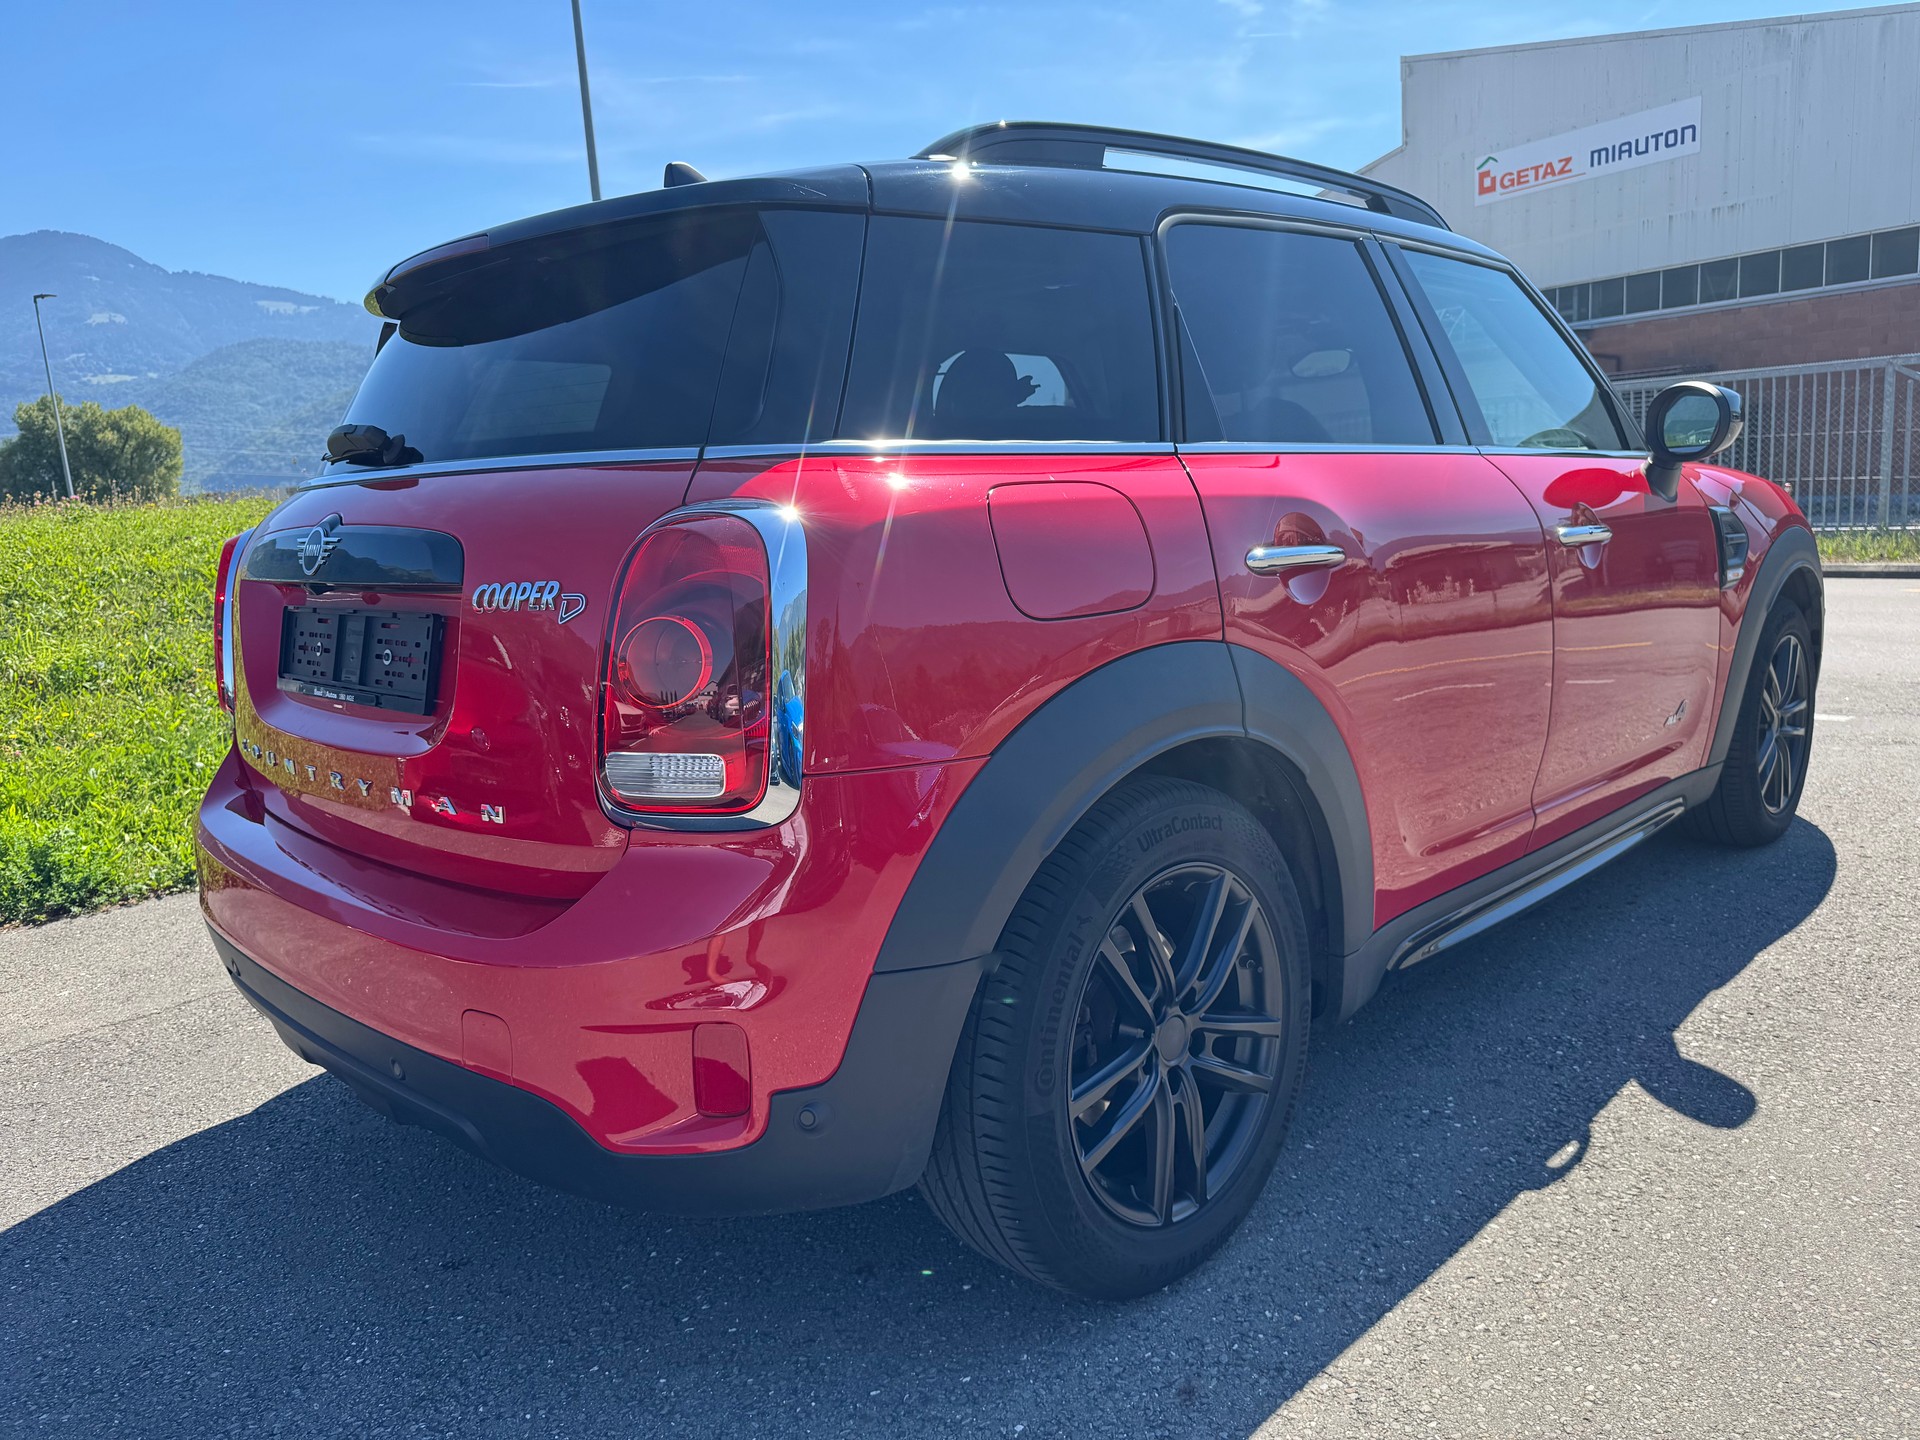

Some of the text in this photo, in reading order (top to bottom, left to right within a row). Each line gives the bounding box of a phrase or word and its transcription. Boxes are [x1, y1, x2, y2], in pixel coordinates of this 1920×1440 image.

[1500, 124, 1697, 190] GETAZ MIAUTON
[472, 581, 586, 624] COOPER D
[242, 738, 506, 824] COUNTRYMAN
[1136, 812, 1224, 853] UltraContact
[1033, 930, 1086, 1098] Continental
